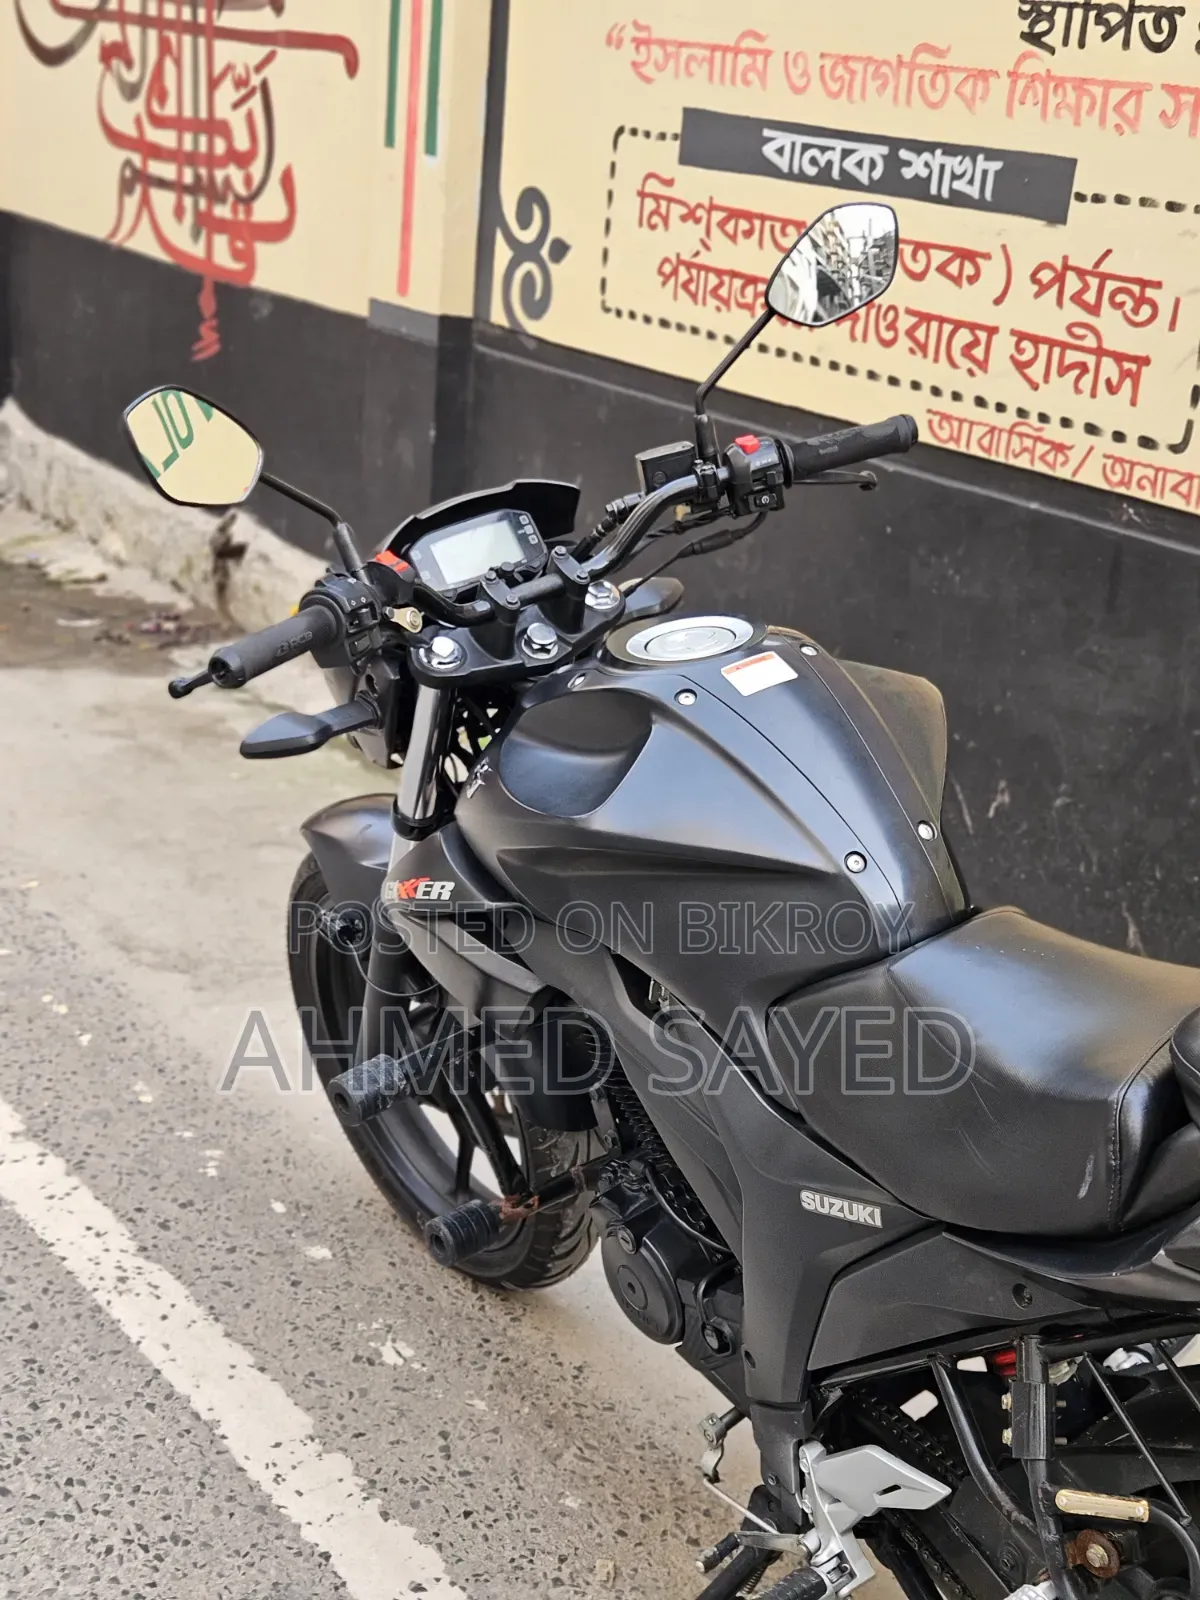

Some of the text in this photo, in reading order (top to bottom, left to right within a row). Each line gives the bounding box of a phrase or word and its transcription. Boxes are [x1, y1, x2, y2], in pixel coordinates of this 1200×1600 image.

[784, 50, 811, 96] ও
[819, 42, 1000, 115] জাগতিক
[1006, 50, 1153, 136] শিক্ষার
[762, 127, 1003, 202] বালক শাখা
[1009, 321, 1152, 408] হাদীস
[801, 1191, 882, 1226] SUZUKI
